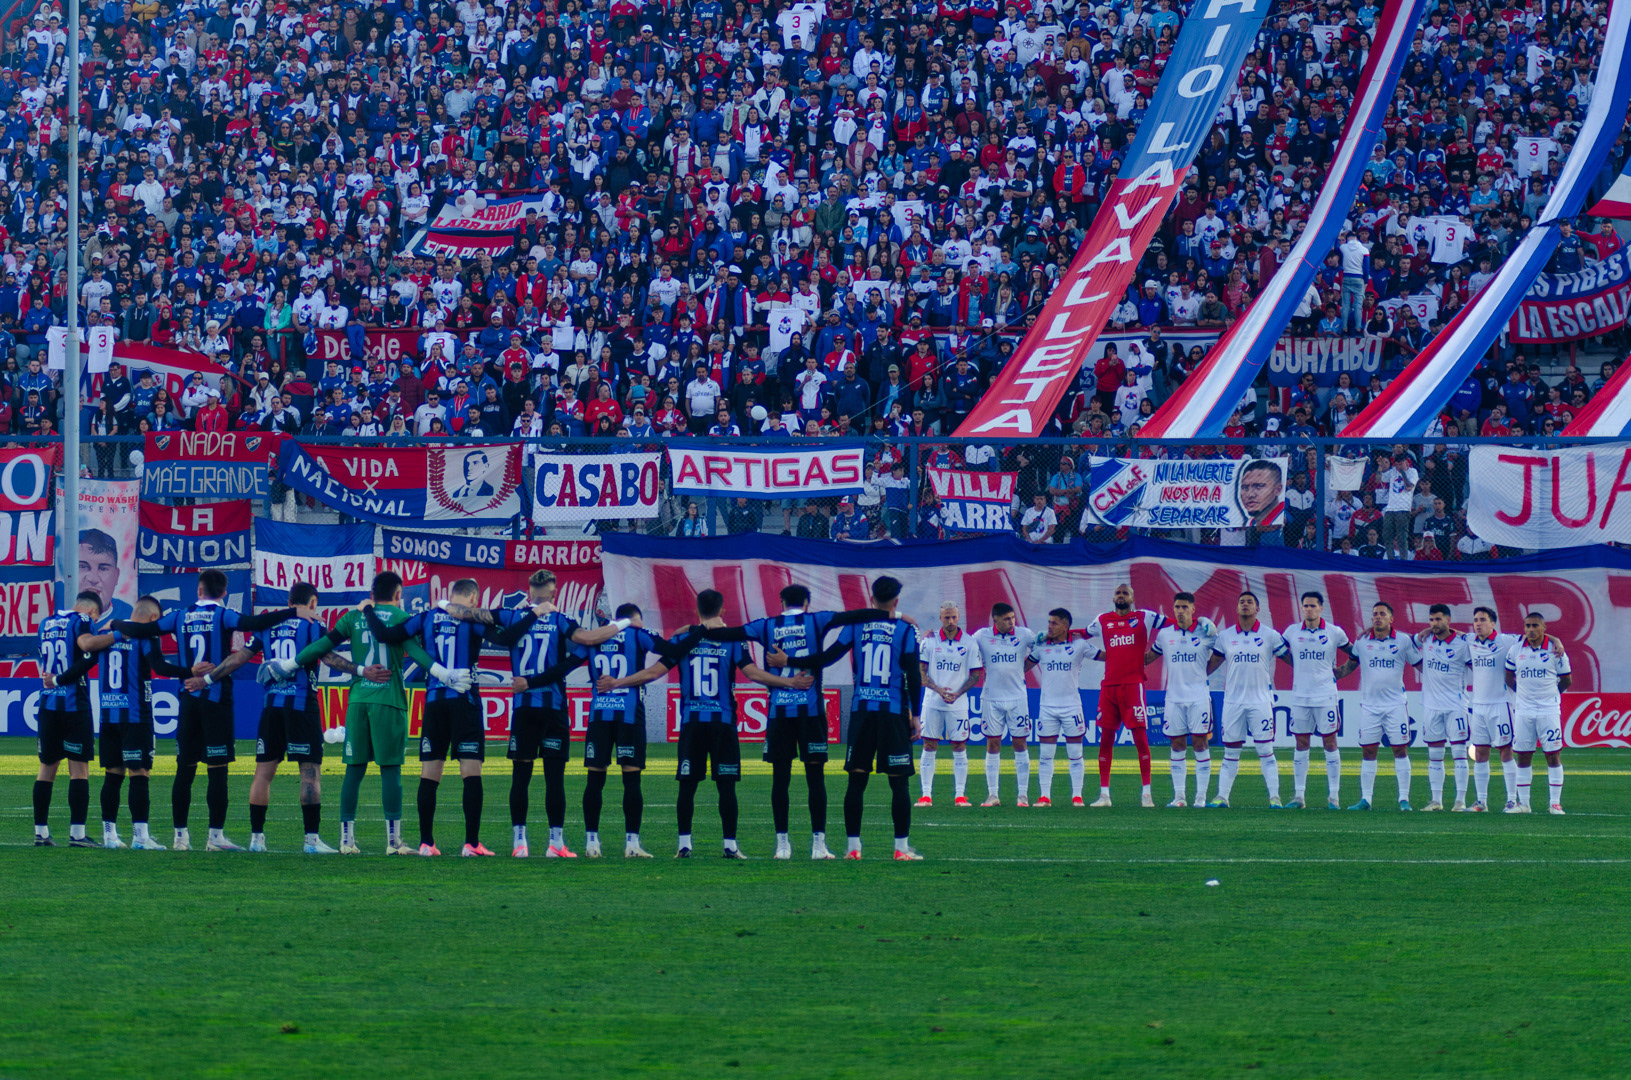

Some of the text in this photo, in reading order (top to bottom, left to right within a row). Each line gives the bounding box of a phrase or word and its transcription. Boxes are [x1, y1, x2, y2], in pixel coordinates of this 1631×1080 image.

[791, 15, 801, 29] 3
[1324, 31, 1335, 45] 3
[1529, 142, 1539, 156] 3
[904, 208, 914, 222] 3
[1445, 227, 1456, 242] 3
[1554, 253, 1624, 296] PIBES
[1417, 303, 1427, 318] 3
[1518, 304, 1547, 339] LA
[98, 334, 108, 348] 3
[180, 431, 236, 457] NADA
[342, 457, 399, 477] VIDA
[676, 454, 863, 488] ARTIGAS
[1186, 463, 1236, 485] MUERTE
[190, 466, 267, 495] GRANDE
[536, 457, 660, 507] CASABÓ
[928, 469, 1012, 500] VILLA
[1161, 486, 1191, 502] NOS
[171, 507, 214, 531] LA
[1149, 505, 1231, 525] SEPARAR
[140, 531, 245, 563] UNION
[390, 535, 452, 560] SOMOS
[466, 543, 500, 564] LOS
[263, 558, 365, 588] LA SUB 21
[187, 624, 214, 633] ELIZALDE
[245, 635, 256, 647] 3
[781, 639, 807, 650] AMARO
[872, 634, 893, 644] ROSSO
[1109, 634, 1135, 648] antel
[41, 639, 69, 675] 23
[189, 634, 206, 669] 2
[270, 638, 297, 662] 10
[434, 634, 456, 670] 11
[517, 632, 550, 677] 27
[991, 652, 1018, 663] antel
[1171, 651, 1197, 663] antel
[1233, 651, 1260, 664] antel
[1299, 648, 1326, 661] antel
[861, 642, 892, 685] 14
[936, 659, 962, 672] antel
[1046, 660, 1072, 672] antel
[1369, 656, 1395, 669] antel
[1427, 658, 1450, 673] antel
[1473, 655, 1496, 668] antel
[108, 650, 123, 690] 8
[594, 653, 630, 694] 22
[689, 656, 719, 697] 15
[1520, 666, 1546, 679] antel
[1132, 705, 1145, 718] 12
[1201, 711, 1209, 724] 2
[1327, 710, 1336, 723] 9
[956, 719, 970, 732] 70
[1071, 714, 1084, 728] 14
[1261, 718, 1275, 732] 23
[1455, 716, 1466, 731] 11
[1400, 722, 1409, 736] 8
[1497, 722, 1511, 737] 10
[1546, 727, 1562, 742] 22
